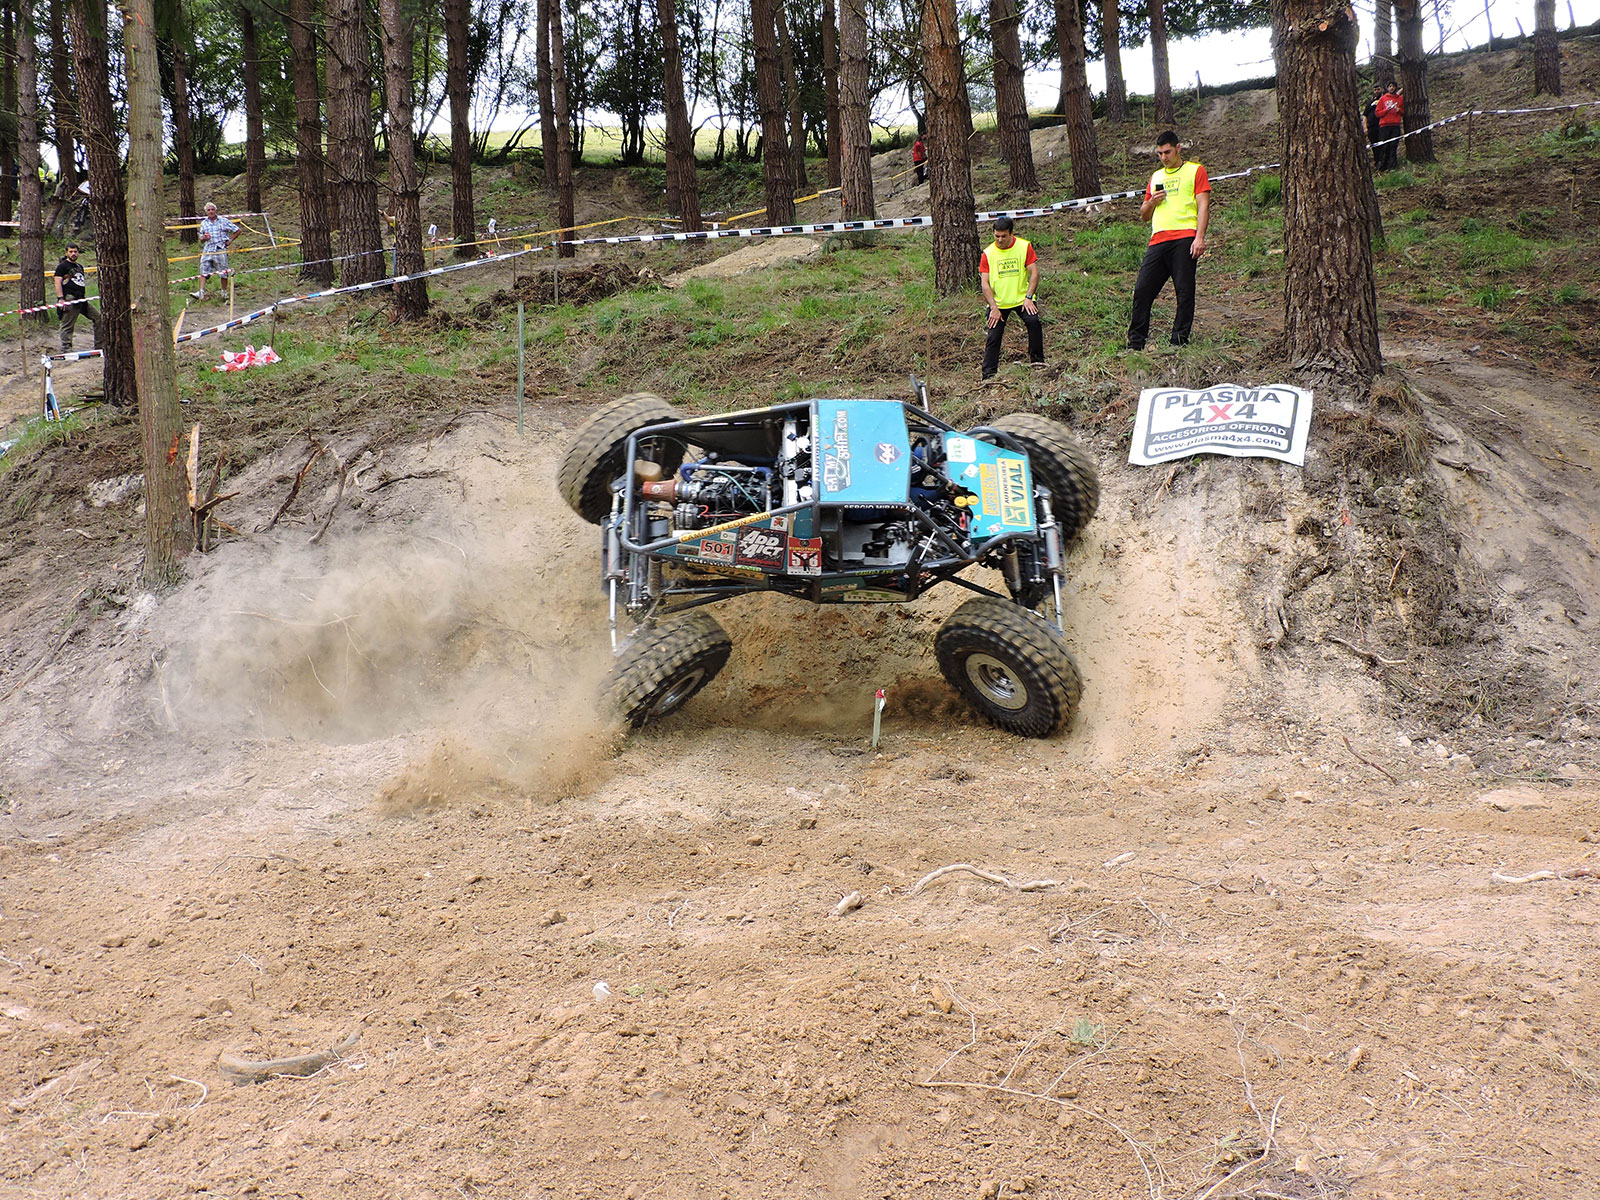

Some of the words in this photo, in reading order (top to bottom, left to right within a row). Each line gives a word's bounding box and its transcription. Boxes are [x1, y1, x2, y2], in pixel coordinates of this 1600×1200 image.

[1164, 390, 1281, 409] PLASMA
[1182, 403, 1258, 424] 4X4
[1152, 424, 1226, 443] ACCESORIOS
[1229, 423, 1287, 436] OFFROAD
[1154, 434, 1282, 452] www.plasma4x4.com
[1000, 460, 1010, 503] AUTOESCUELA
[1008, 463, 1025, 503] VIAL
[704, 542, 731, 555] 501
